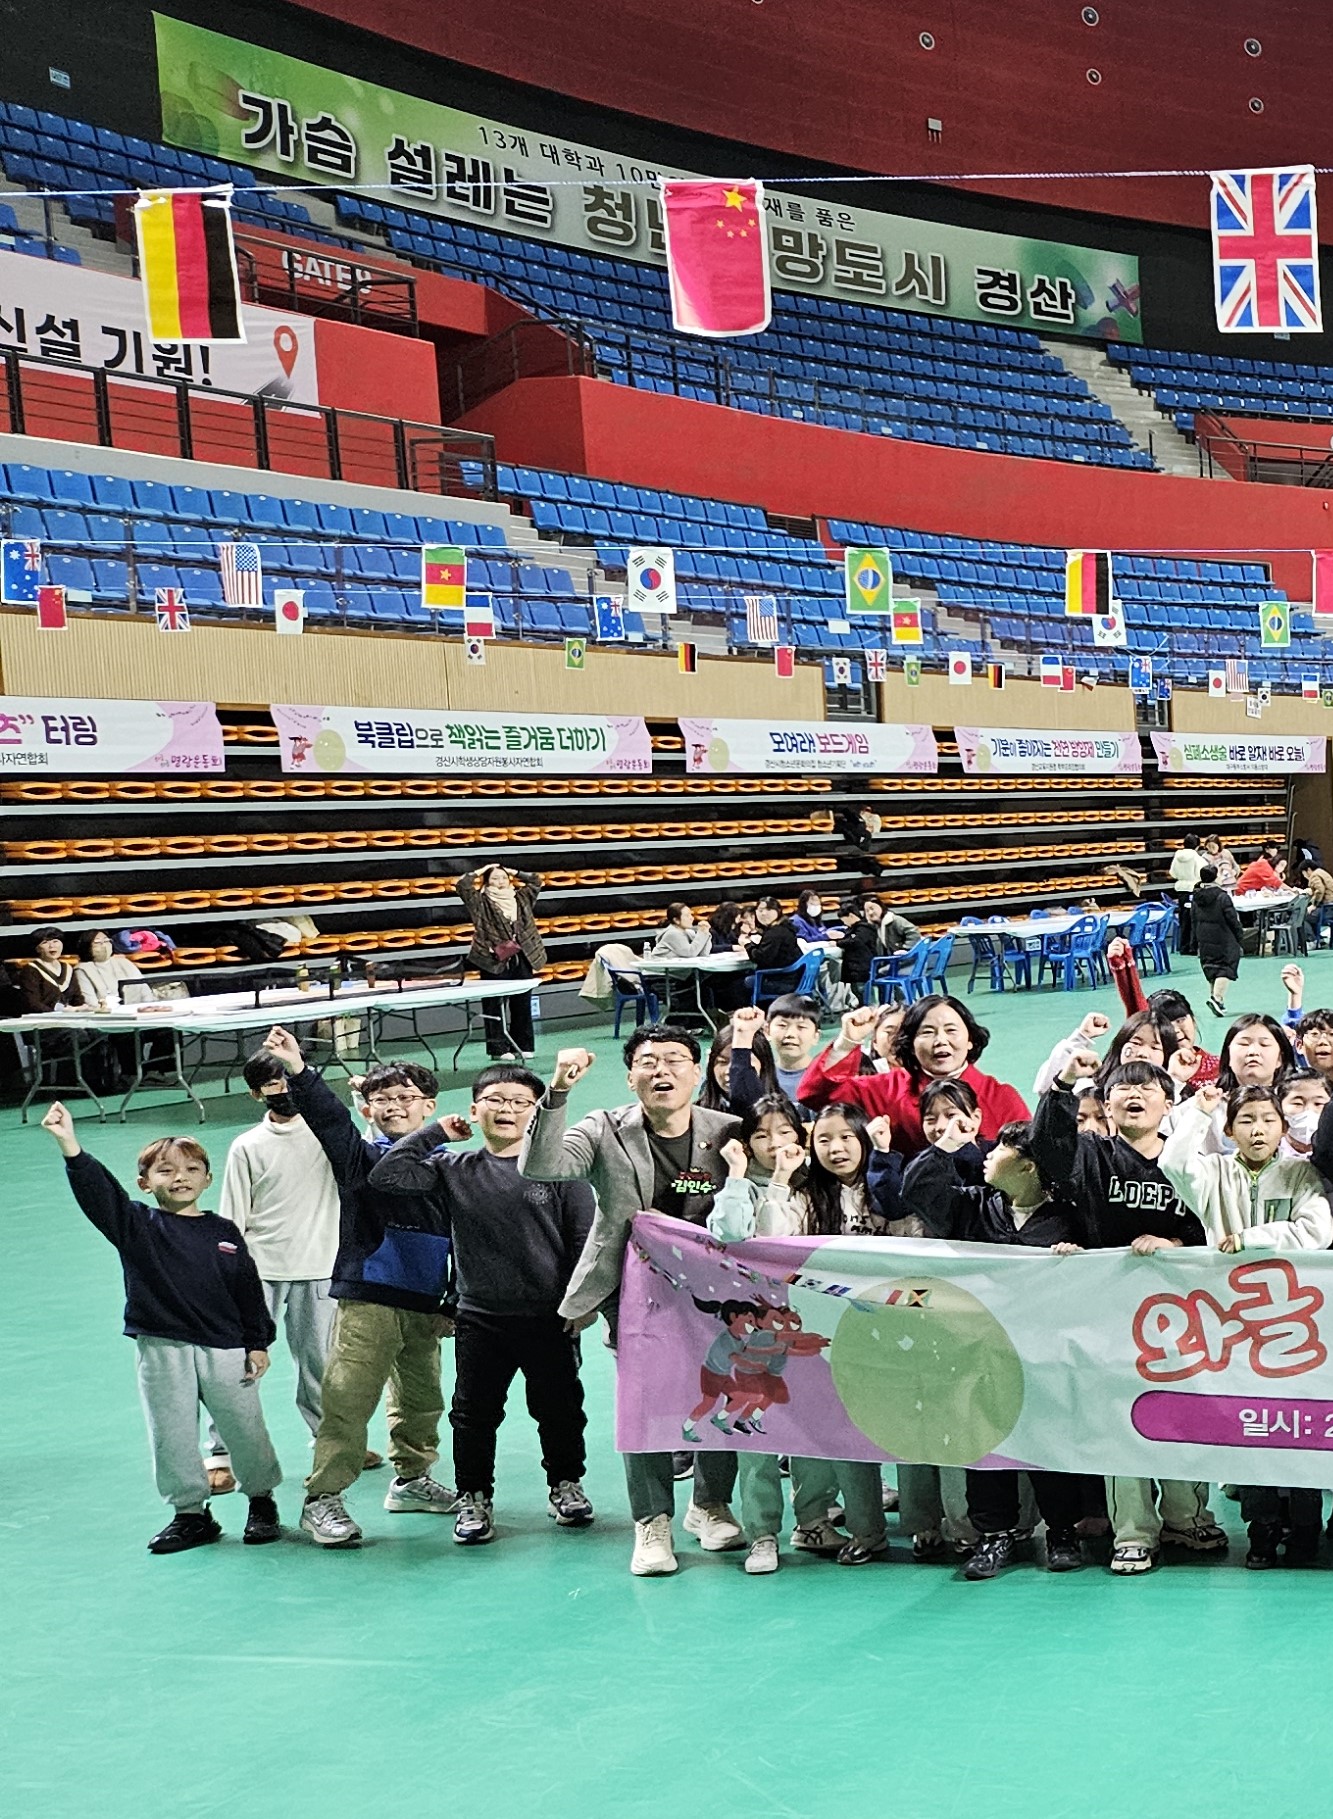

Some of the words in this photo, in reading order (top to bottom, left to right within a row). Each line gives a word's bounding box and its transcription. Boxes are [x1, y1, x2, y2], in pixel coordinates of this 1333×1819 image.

[479, 127, 529, 157] 13개
[539, 143, 605, 177] 대학과
[764, 197, 805, 223] 재를
[815, 207, 856, 231] 품은
[240, 91, 355, 178] 가슴
[386, 135, 552, 227] 설레는
[975, 267, 1076, 323] 경산
[102, 325, 212, 386] 기원!
[41, 715, 99, 745] 터링
[502, 725, 556, 752] 즐거움
[557, 727, 608, 752] 더하기
[816, 732, 869, 755] 보드게임
[1229, 745, 1246, 761] 바로
[1268, 745, 1285, 761] 바로
[674, 1180, 713, 1194] 김인수
[1133, 1259, 1327, 1382] 와글
[1239, 1409, 1313, 1437] 일시:
